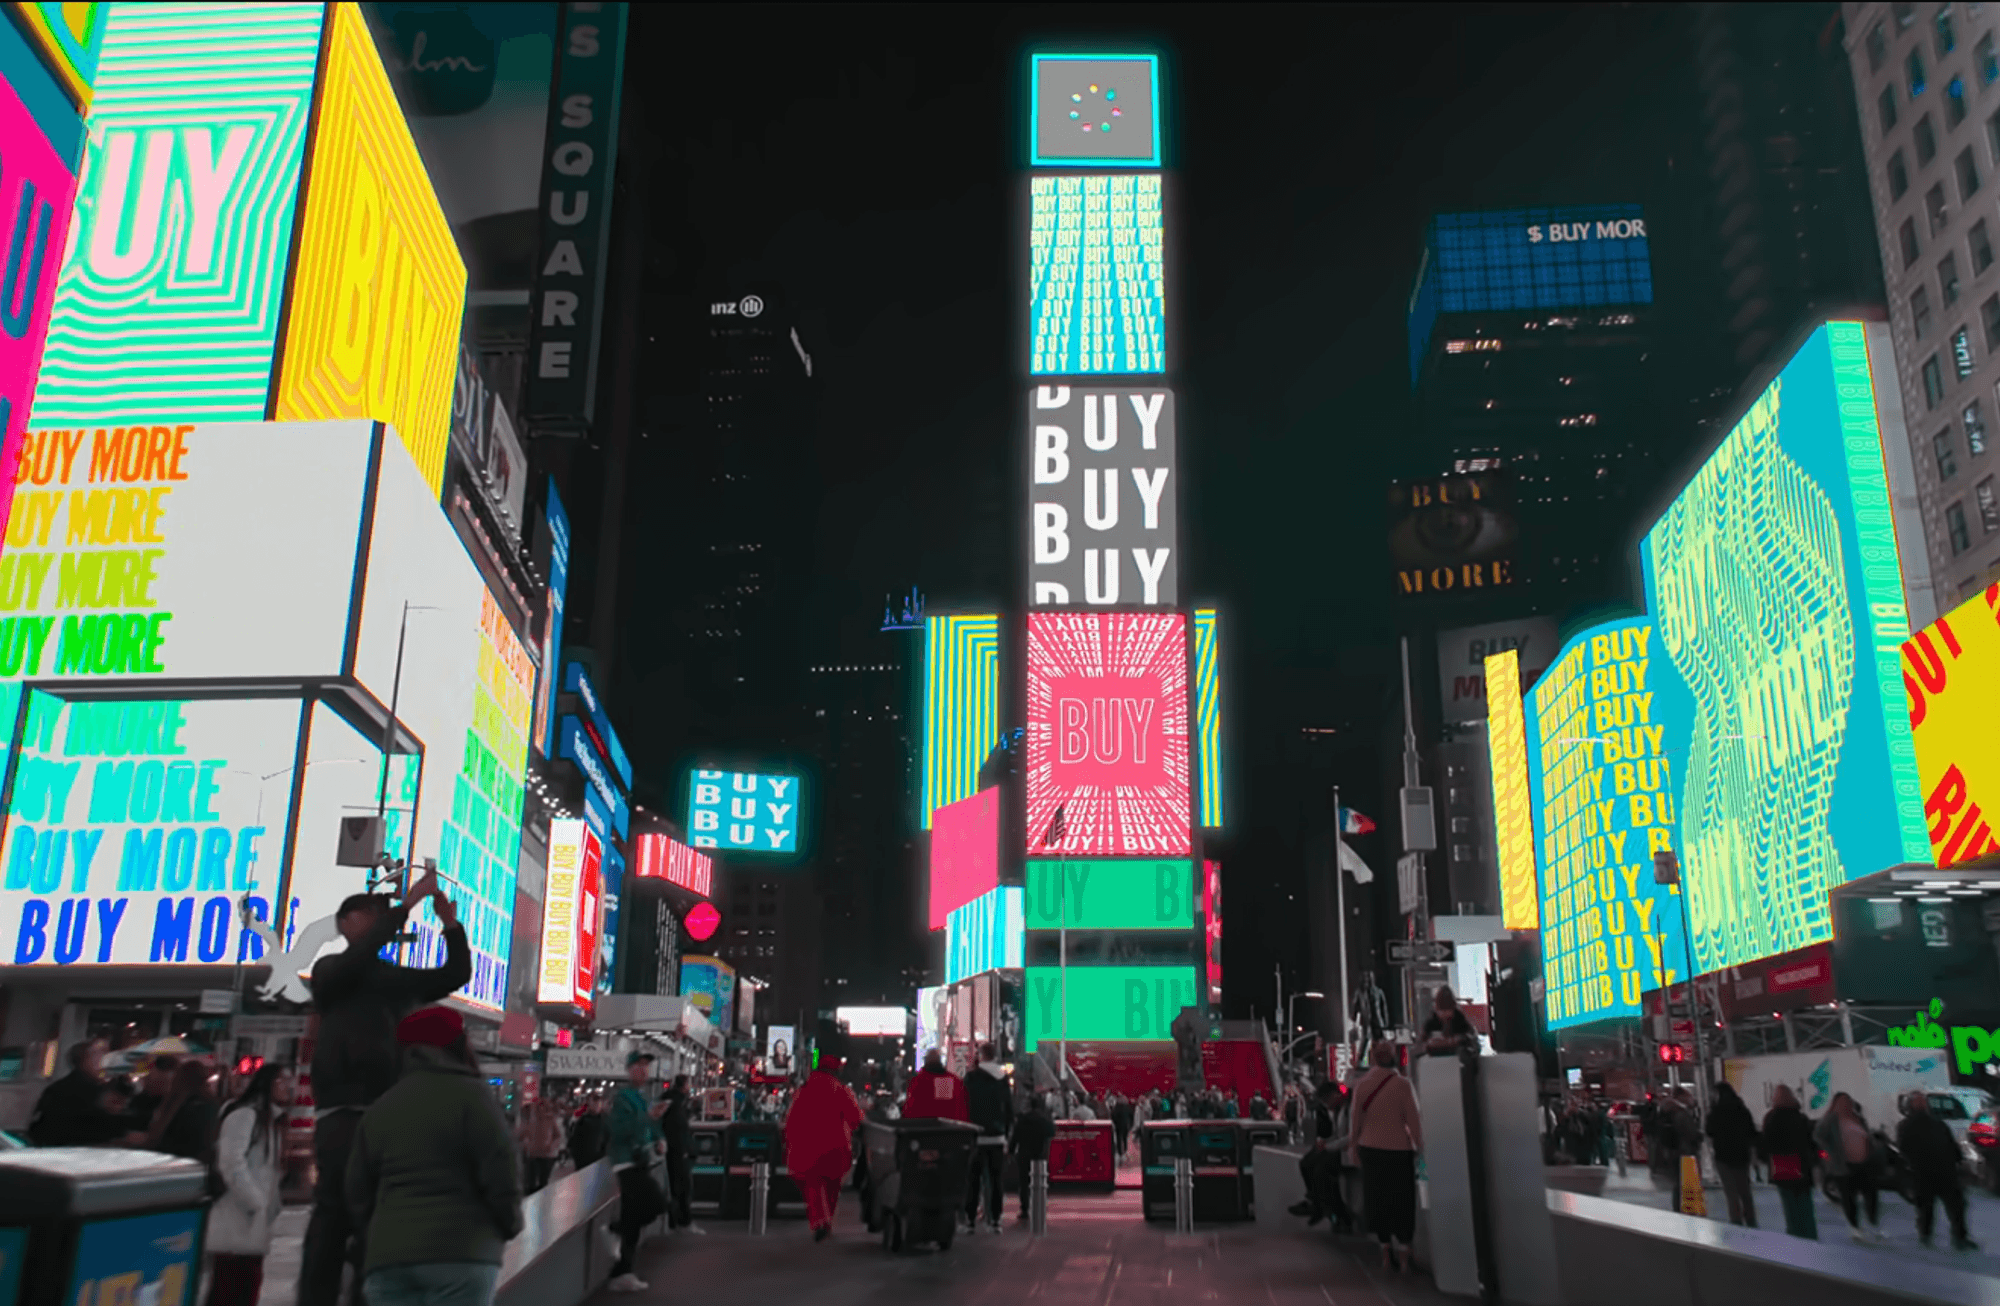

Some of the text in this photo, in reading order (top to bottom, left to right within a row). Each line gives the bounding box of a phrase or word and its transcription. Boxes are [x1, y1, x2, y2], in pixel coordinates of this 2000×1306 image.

[1550, 222, 1591, 242] BUY
[89, 425, 195, 483] MORE
[66, 487, 173, 545] MORE
[55, 549, 167, 609] MORE
[1400, 560, 1512, 593] MORE
[53, 612, 173, 675] MORE
[1591, 626, 1652, 667] BUY
[1591, 659, 1649, 700] BUY
[63, 700, 188, 757] MORE
[1059, 698, 1155, 764] BUY
[1595, 692, 1654, 733] BUY
[1602, 724, 1665, 764] BUY
[88, 759, 228, 824] MORE
[5, 825, 266, 894] BUY MORE
[14, 897, 128, 965] BUY
[1592, 897, 1655, 939] BUY
[1596, 932, 1668, 973] BUY
